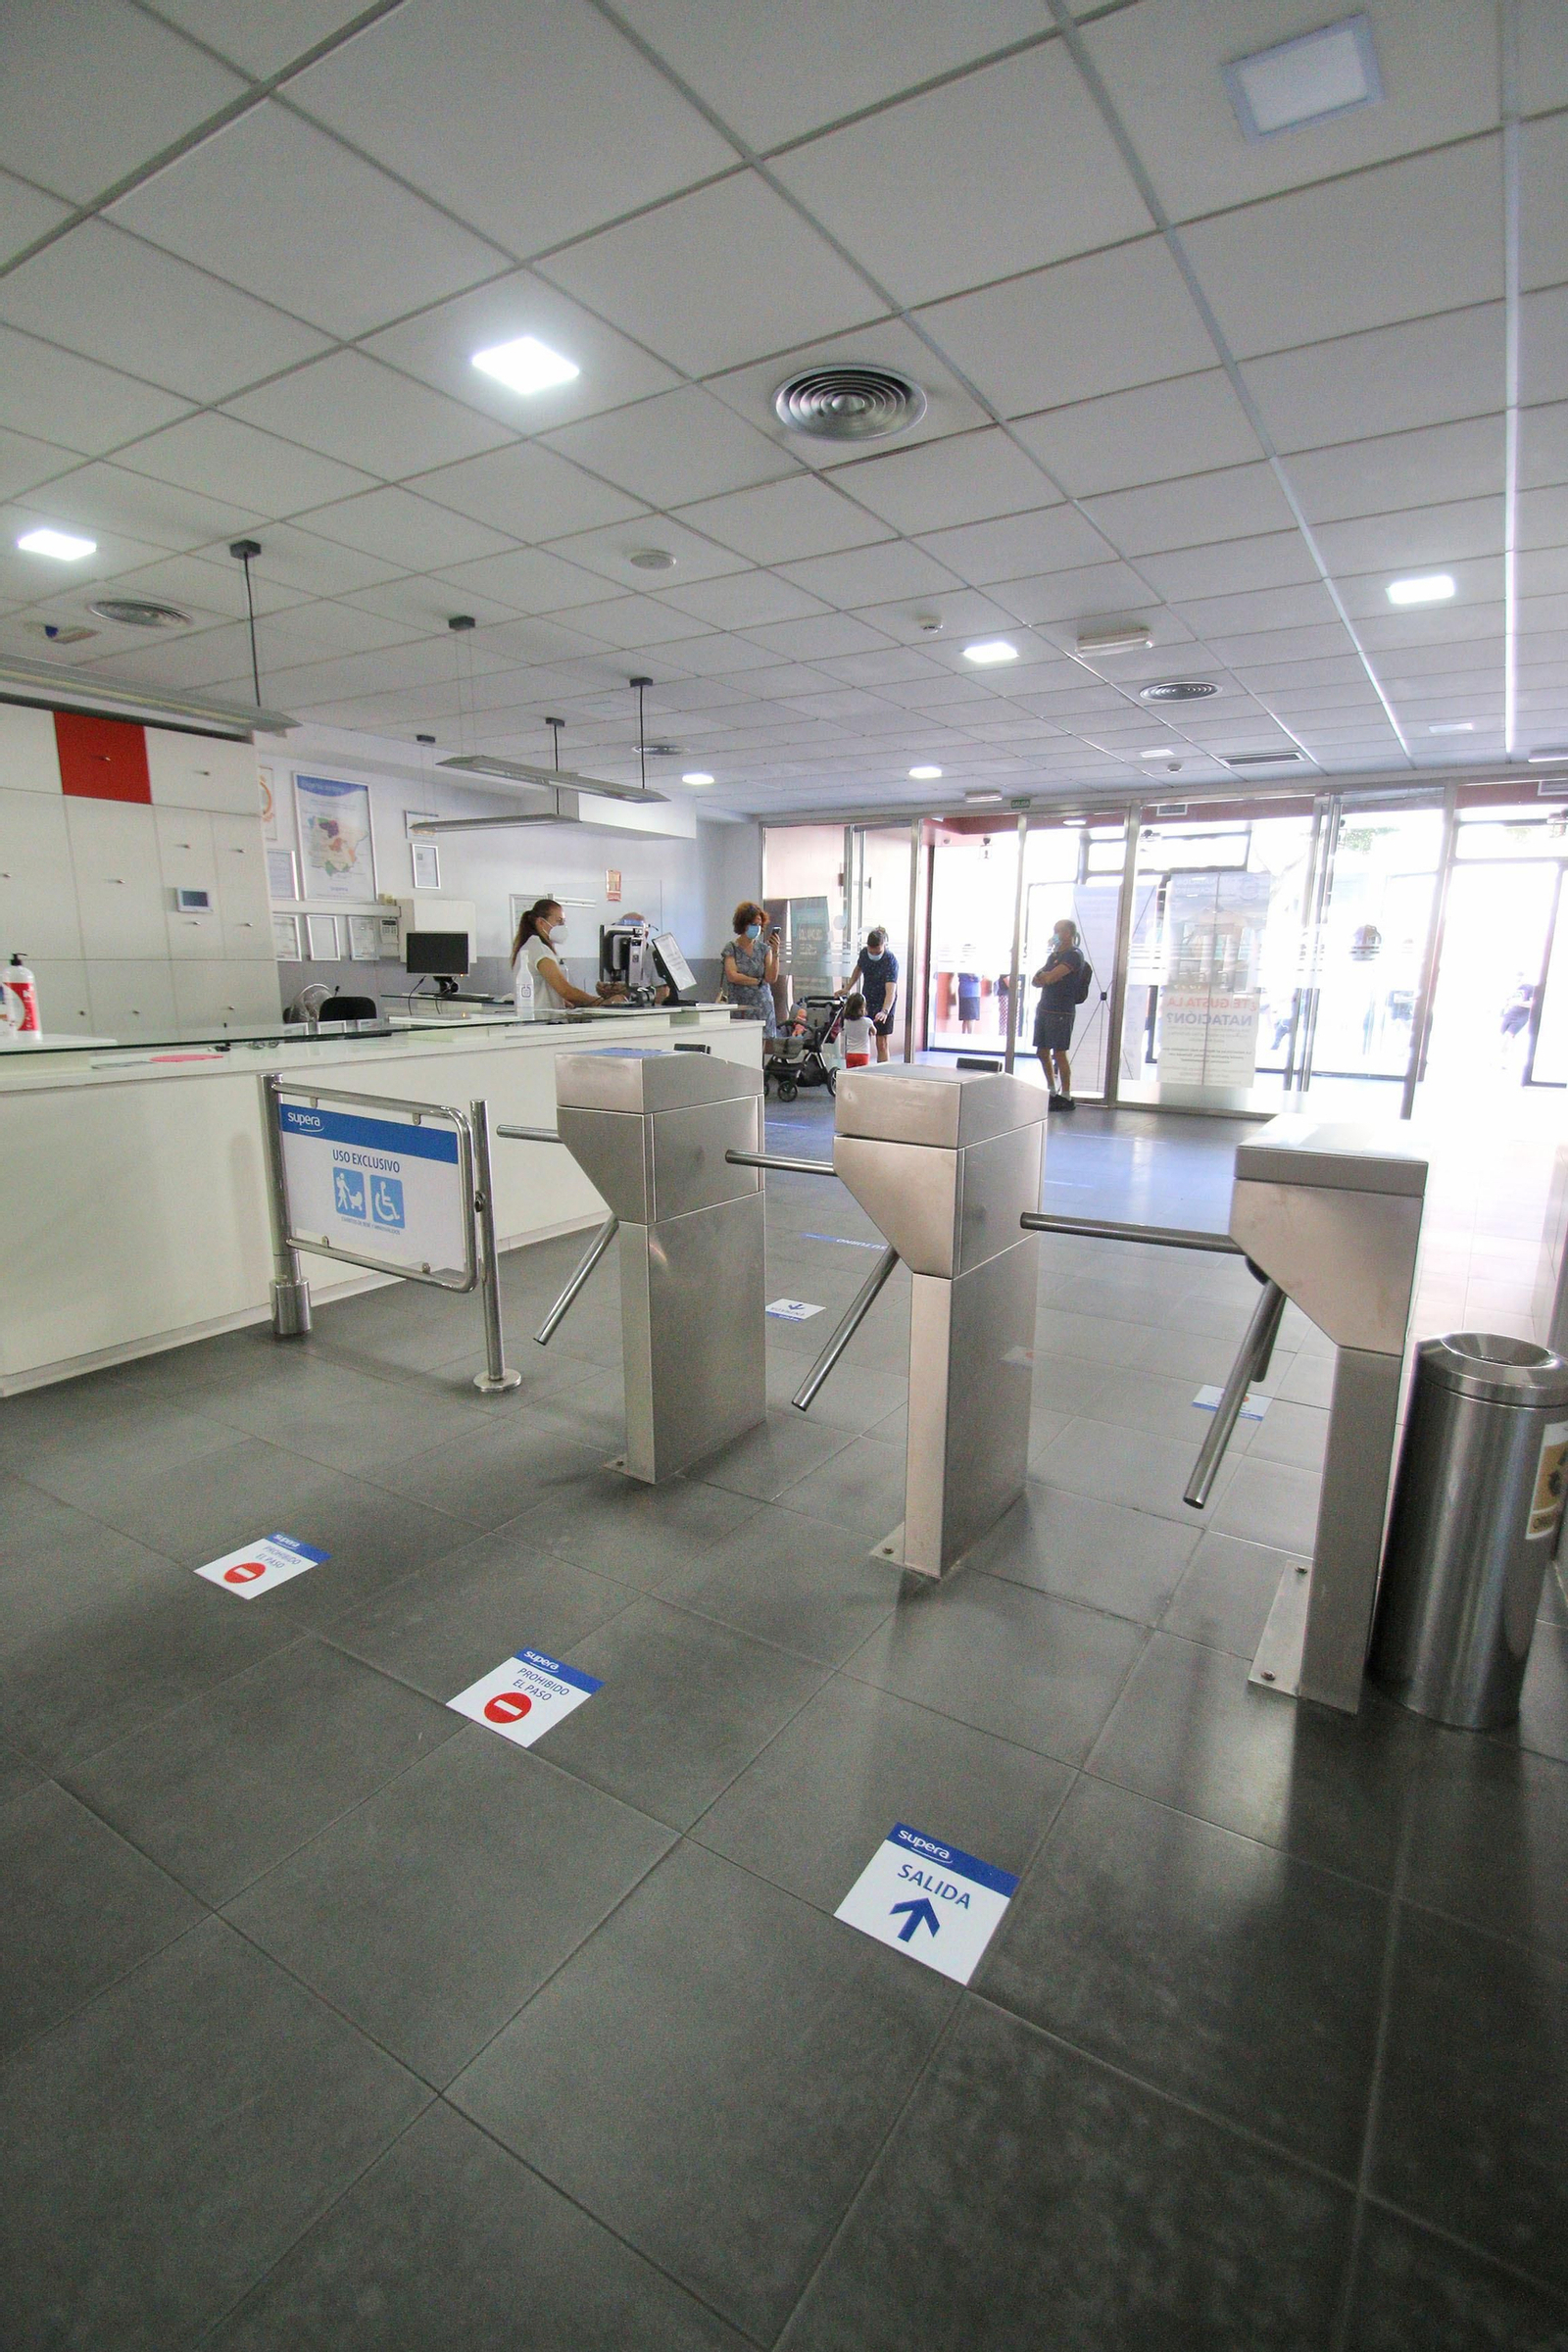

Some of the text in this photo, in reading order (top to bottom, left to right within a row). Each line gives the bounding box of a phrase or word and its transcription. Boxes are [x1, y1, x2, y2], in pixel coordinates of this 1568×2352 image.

[287, 1110, 321, 1127] supera
[332, 1149, 401, 1173] USO EXCLUSIVO
[266, 1556, 285, 1568] PASO
[523, 1650, 560, 1671] supera
[513, 1679, 553, 1701] EL PASO
[517, 1667, 570, 1696] PROHIBIDO
[898, 1829, 951, 1860] supera
[897, 1864, 971, 1910] SALIDA
